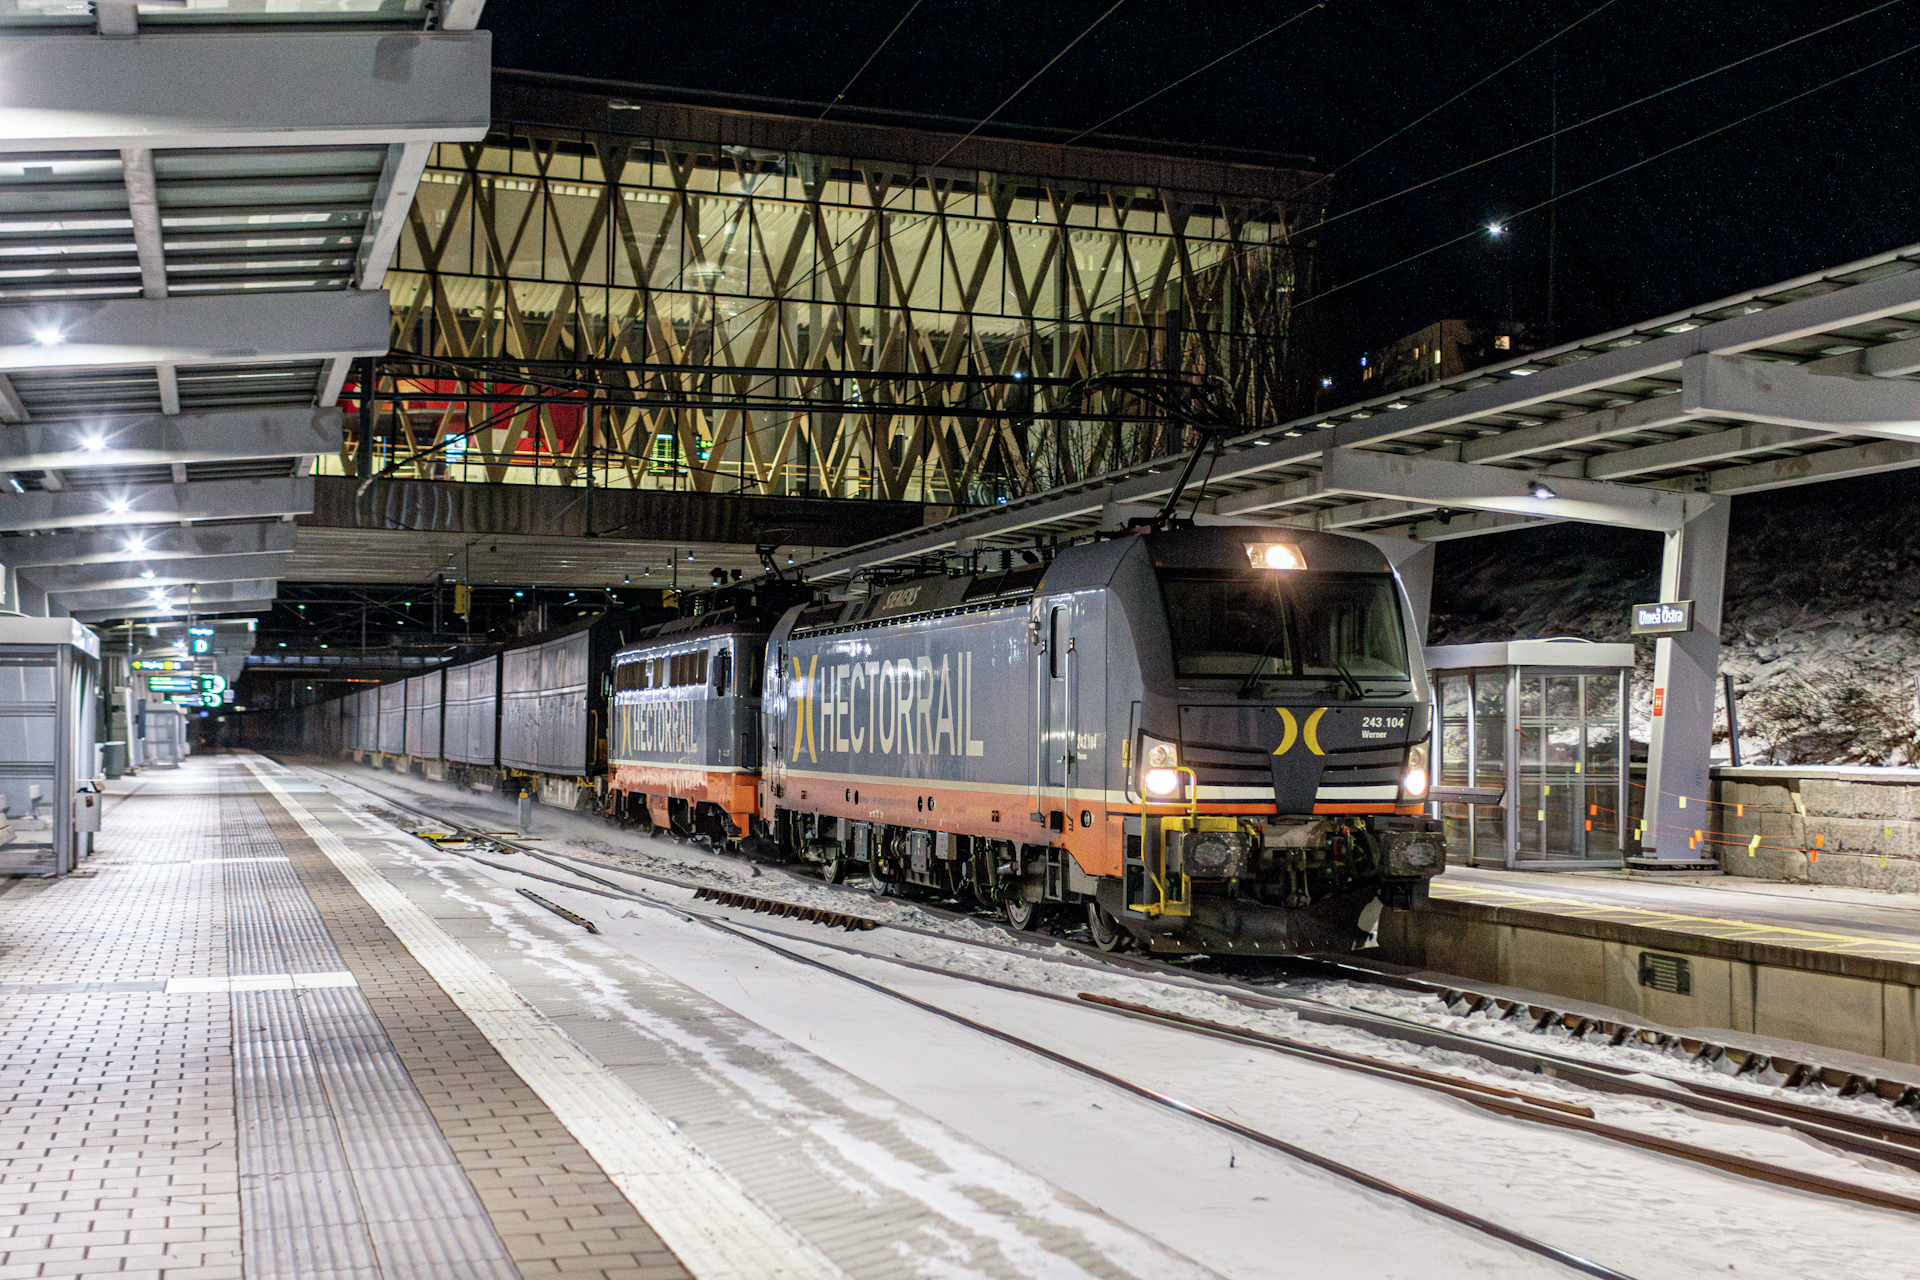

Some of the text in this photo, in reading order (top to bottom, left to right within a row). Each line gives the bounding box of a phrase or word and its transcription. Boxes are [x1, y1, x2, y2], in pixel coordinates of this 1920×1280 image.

[882, 586, 922, 610] SIEMENS
[1638, 604, 1684, 626] Umeå Östra
[193, 639, 208, 653] D
[821, 651, 984, 757] HECTORRAIL
[633, 699, 698, 753] HECTORRAIL
[1362, 716, 1404, 728] 243.104
[1362, 730, 1387, 738] Werner
